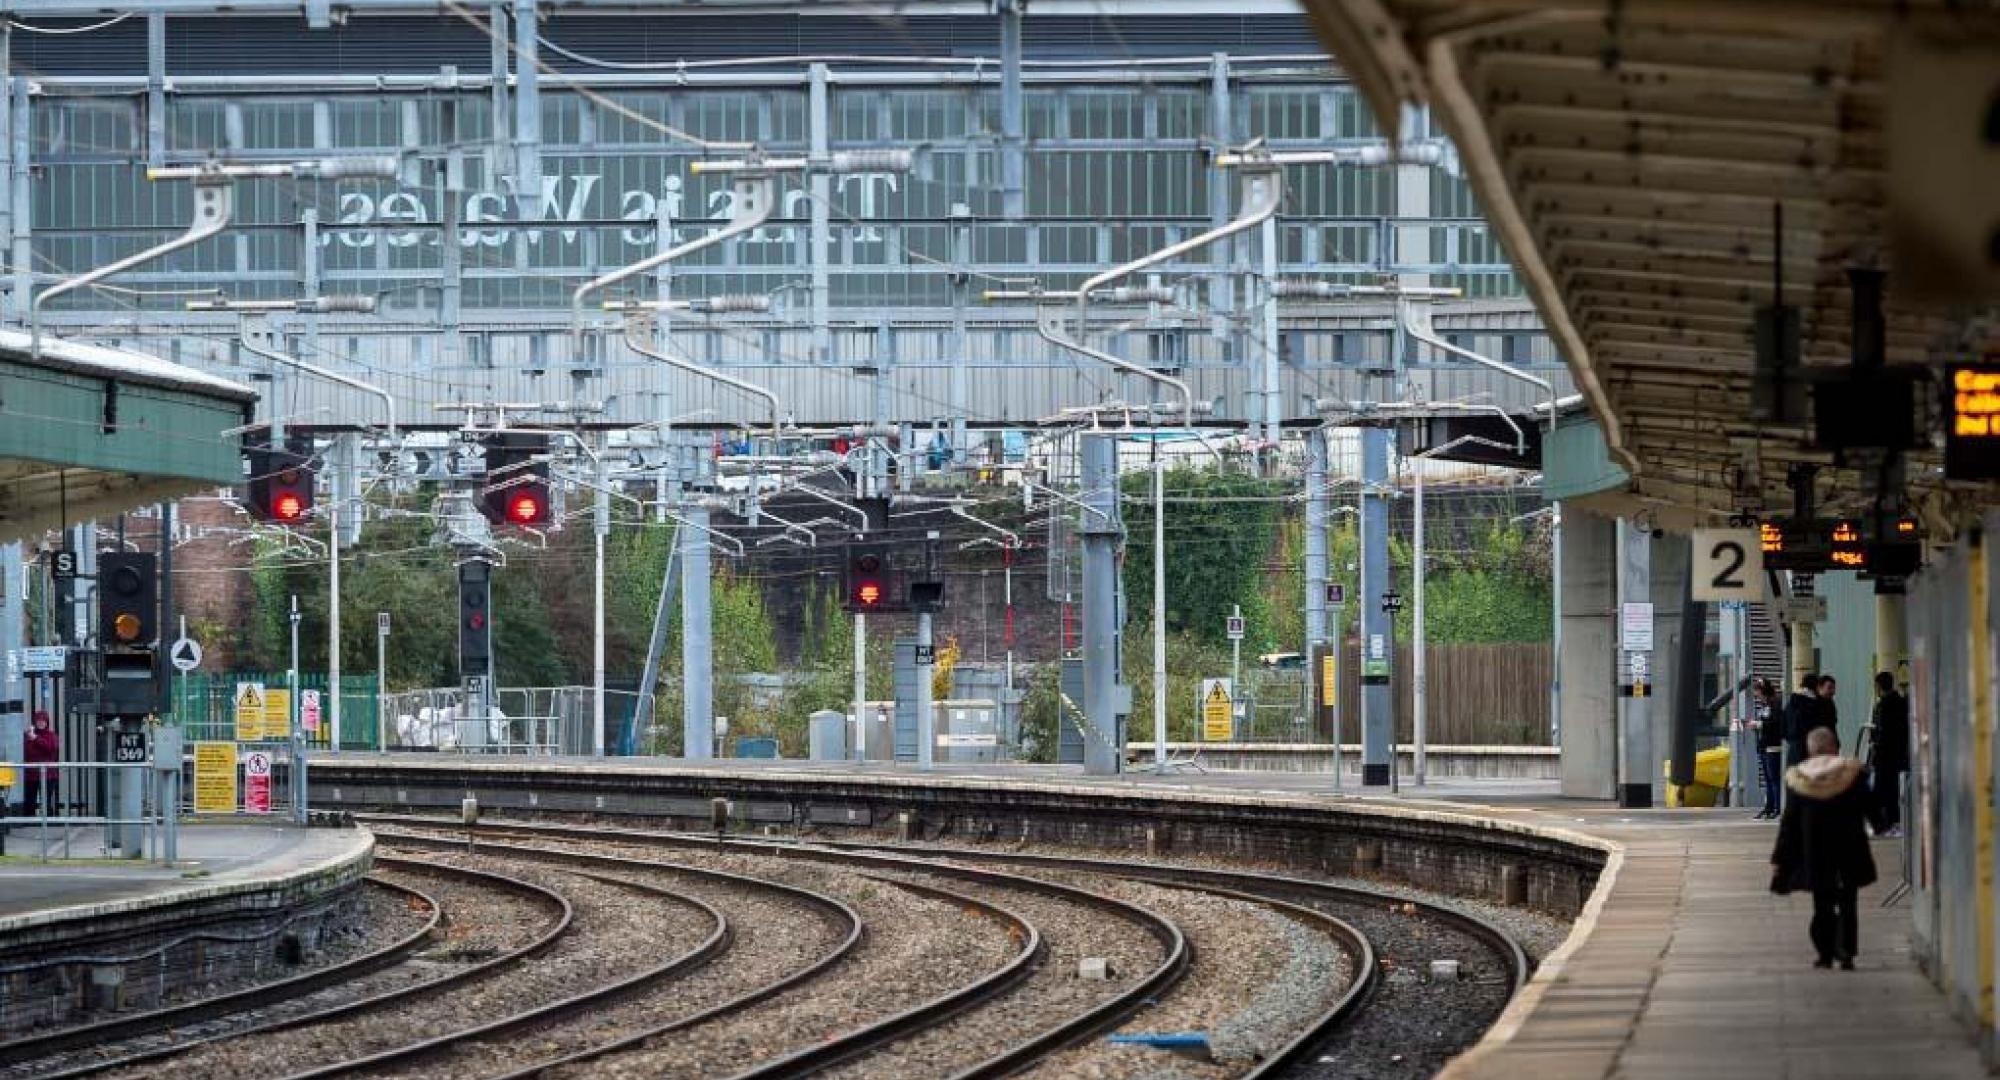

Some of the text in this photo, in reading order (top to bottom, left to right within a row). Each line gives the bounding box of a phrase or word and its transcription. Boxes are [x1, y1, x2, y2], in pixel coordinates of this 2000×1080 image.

[58, 553, 71, 571] S
[1710, 541, 1745, 588] 2
[121, 732, 140, 747] NT
